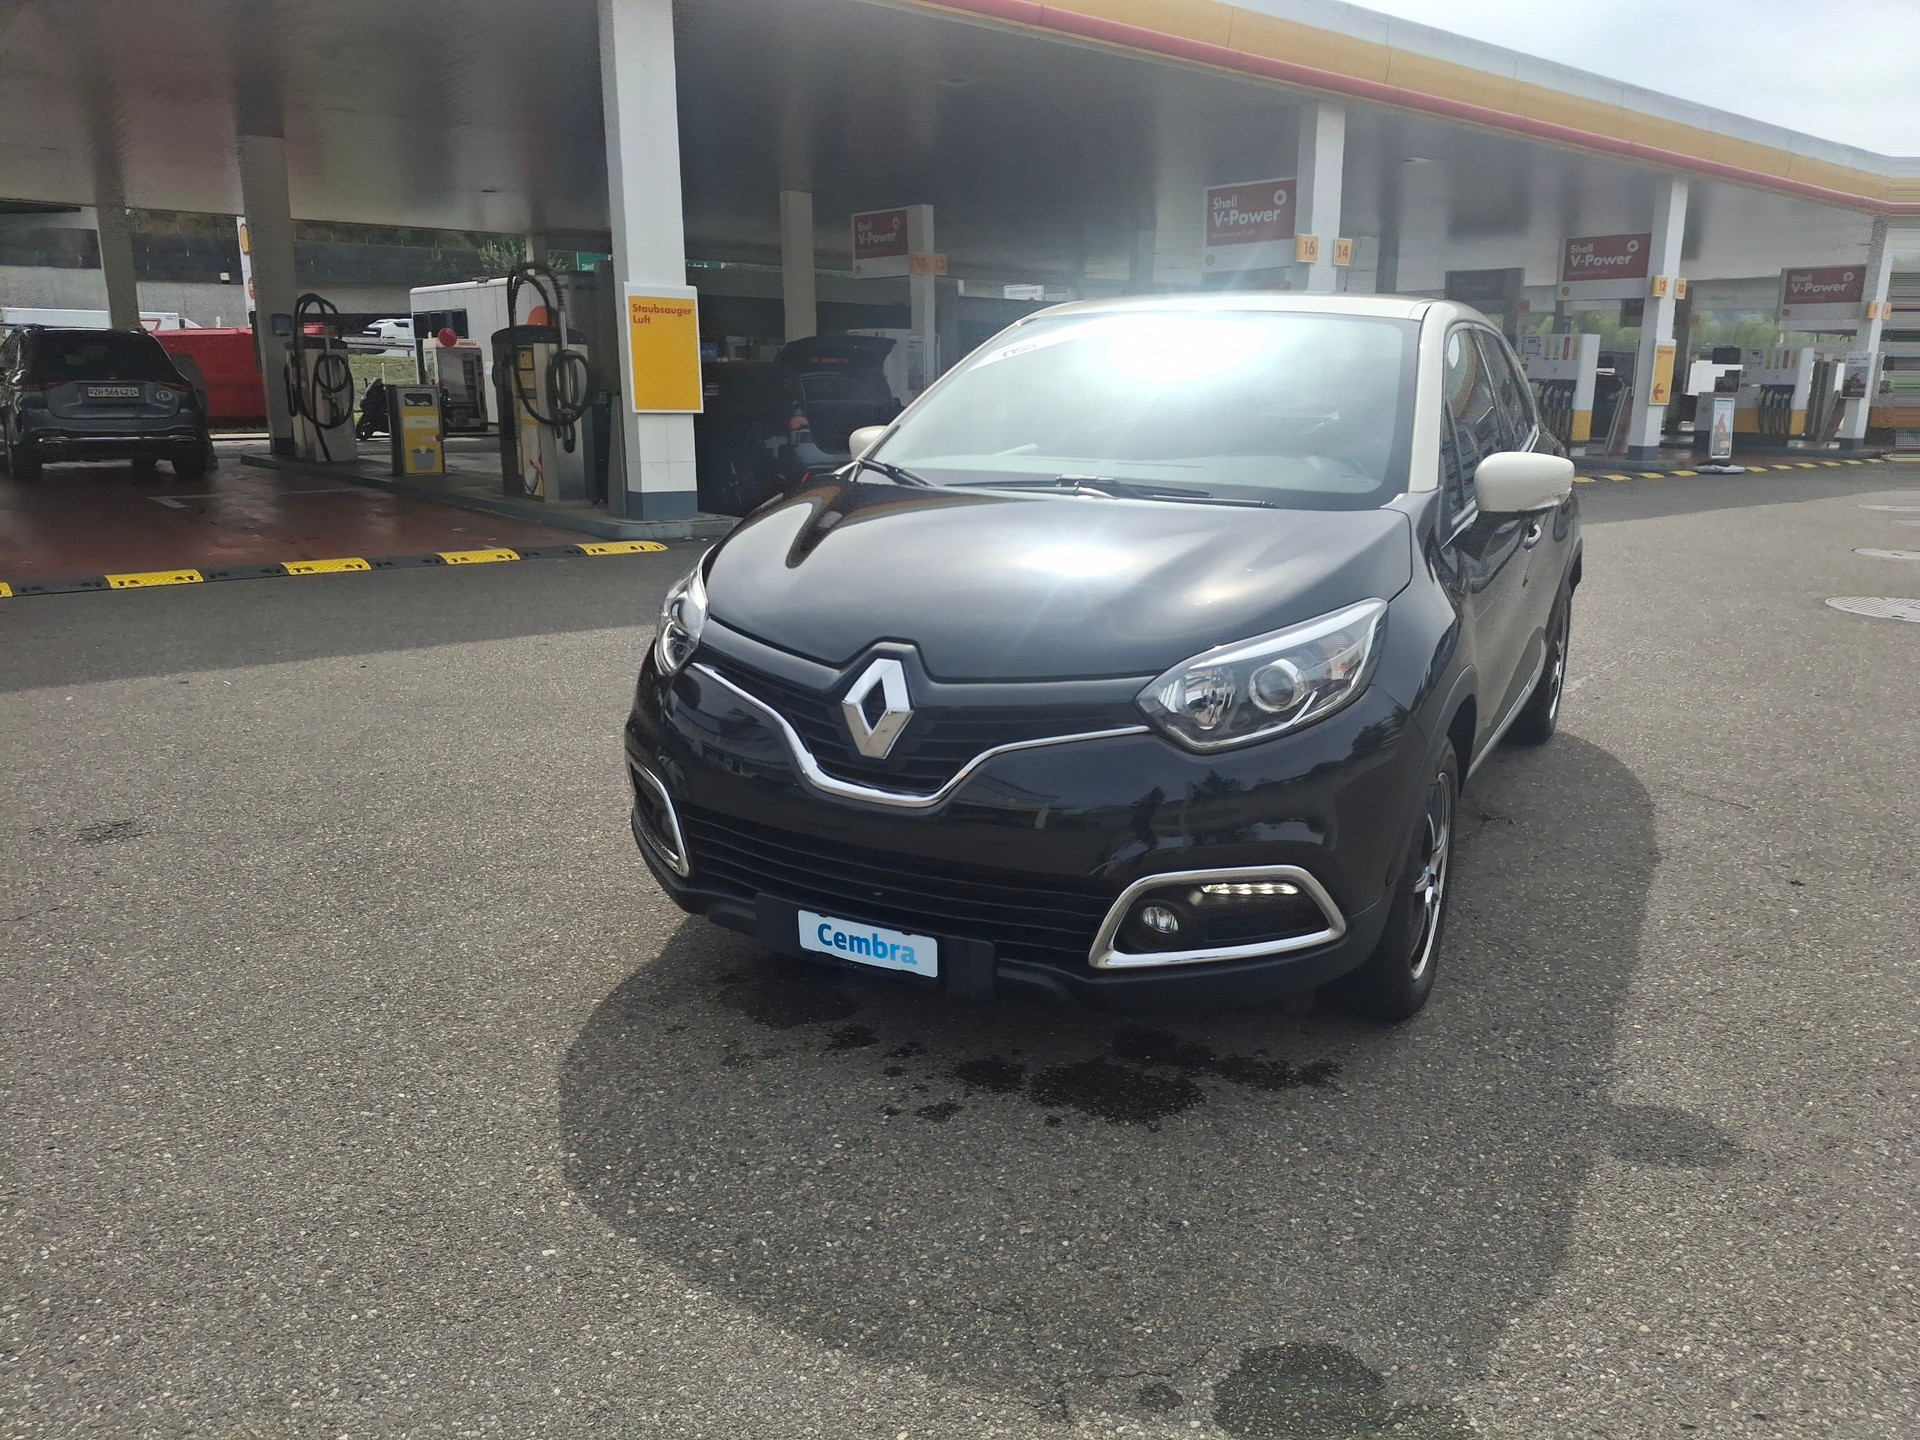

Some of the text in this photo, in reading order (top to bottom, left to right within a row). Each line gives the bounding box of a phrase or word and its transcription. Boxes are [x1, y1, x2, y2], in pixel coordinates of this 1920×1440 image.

[1212, 195, 1237, 210] Shell
[1212, 208, 1281, 228] V-Power
[857, 222, 873, 232] Shell
[858, 232, 897, 245] V-Power
[1304, 240, 1315, 255] 16
[1337, 245, 1348, 258] 14
[1570, 243, 1594, 254] Shell
[1571, 254, 1632, 267] V-Power
[1790, 274, 1812, 282] Shell
[1659, 280, 1667, 292] 12
[1790, 282, 1848, 293] V-Power
[632, 302, 692, 316] Staubsauger
[632, 314, 651, 325] Luft
[158, 392, 169, 400] CH
[817, 923, 918, 965] Cembra
